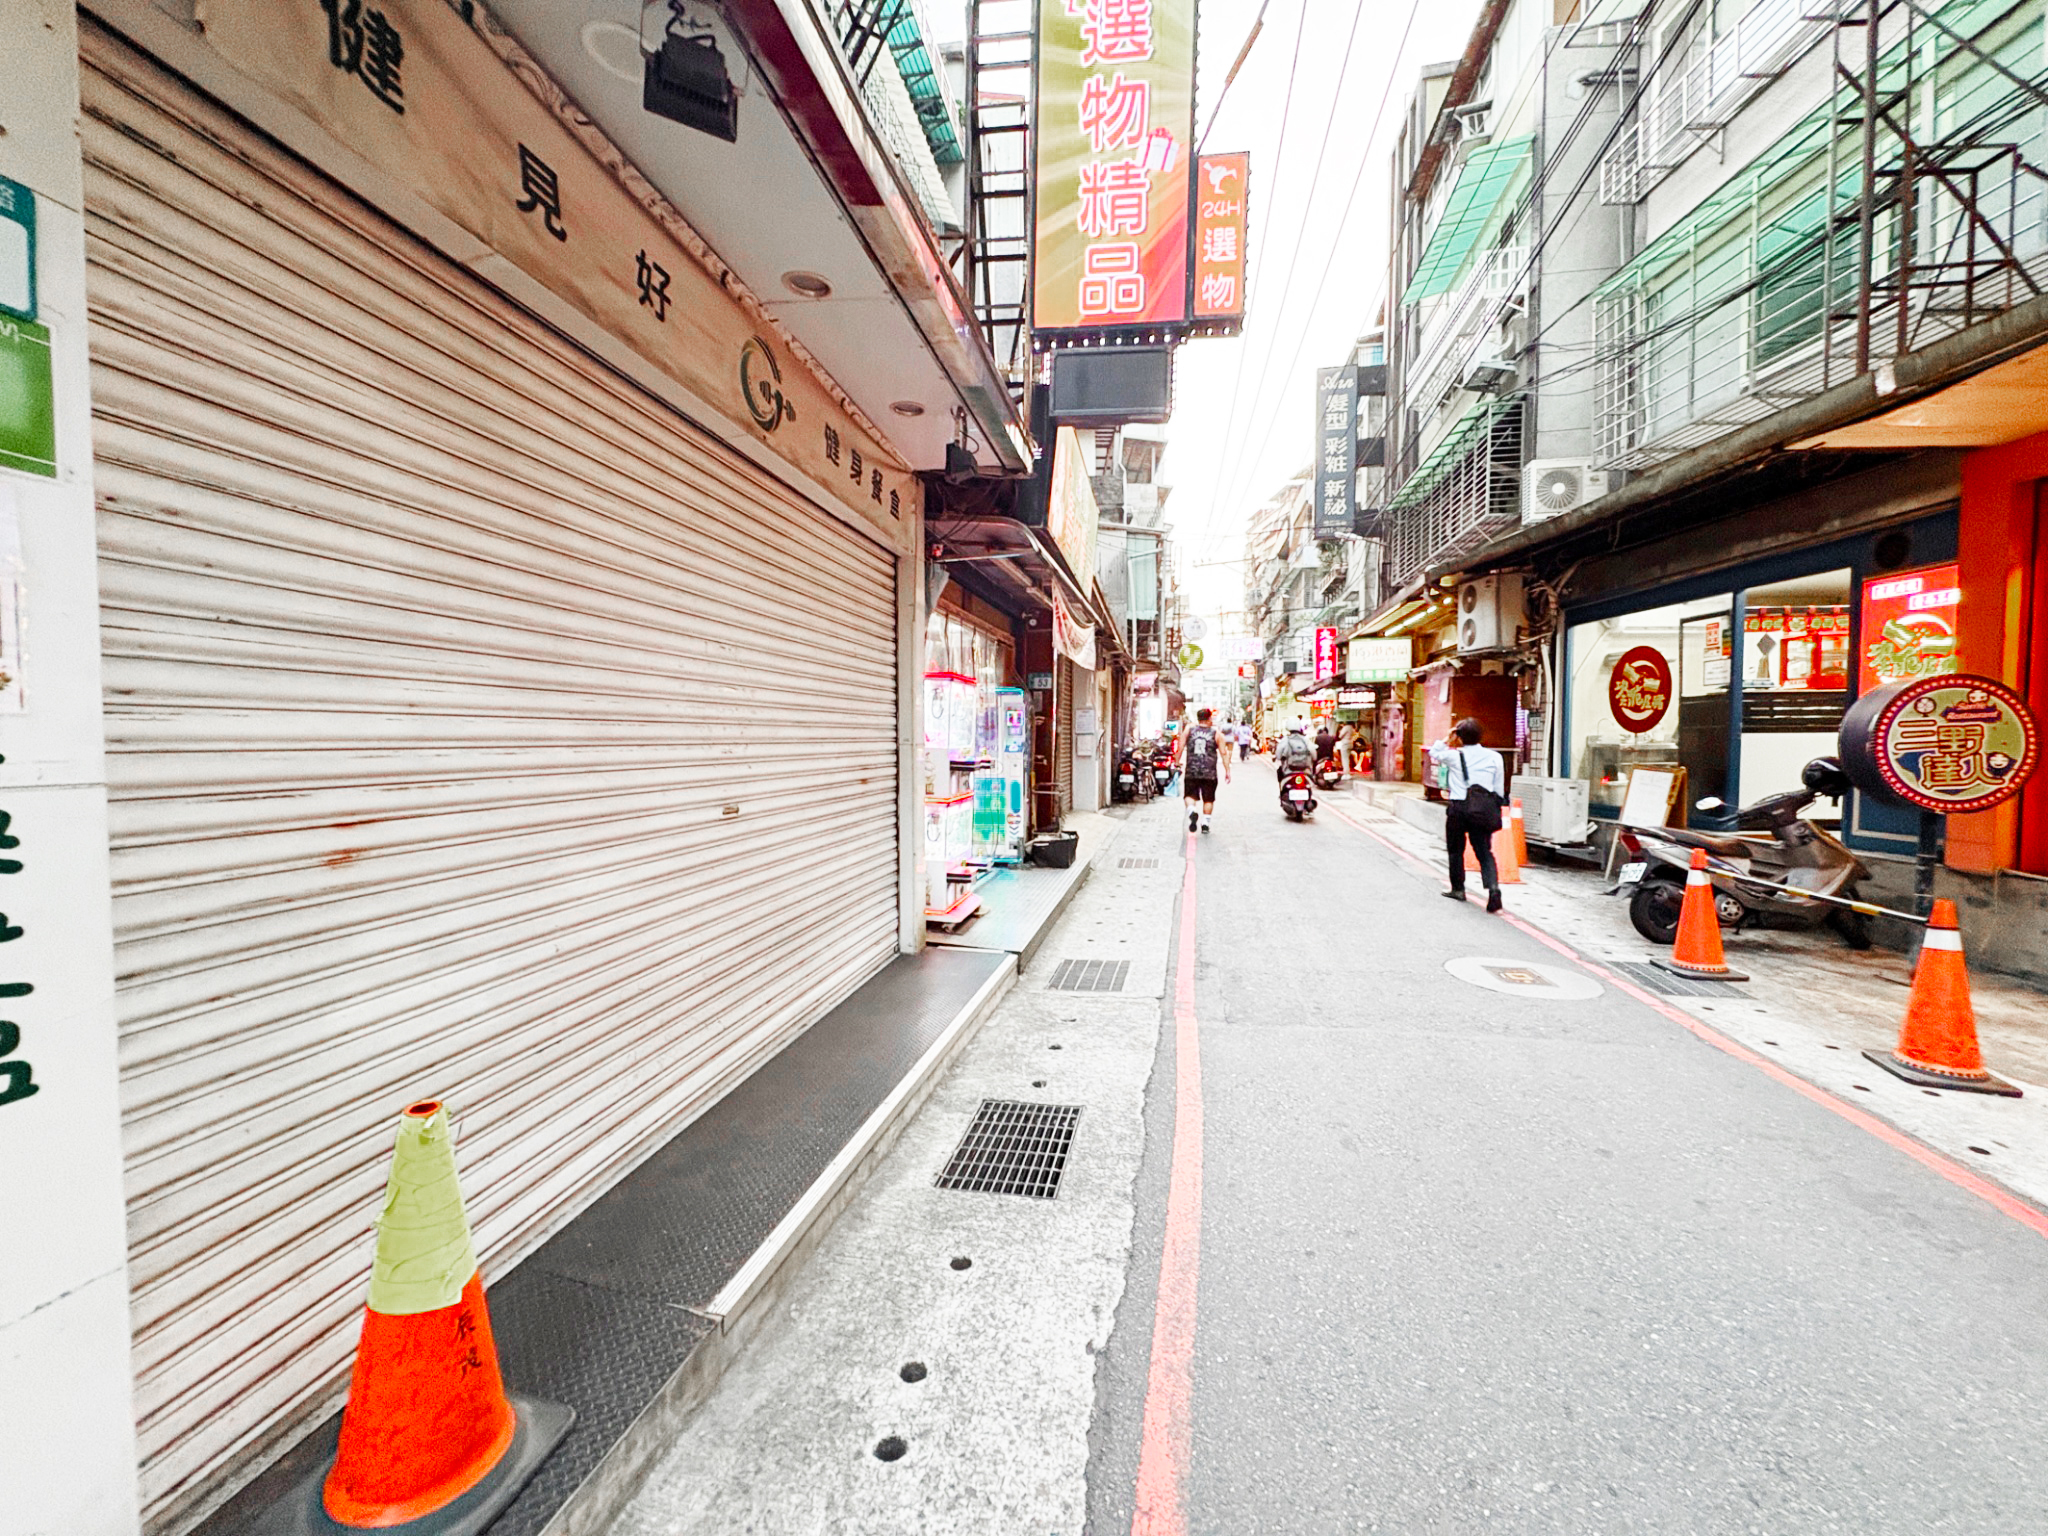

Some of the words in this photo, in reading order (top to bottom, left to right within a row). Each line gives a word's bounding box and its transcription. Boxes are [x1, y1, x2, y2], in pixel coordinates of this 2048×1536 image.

[1077, 0, 1156, 316] 選物精品
[1202, 200, 1242, 219] 24H
[1202, 227, 1238, 310] 選物
[1320, 371, 1355, 391] Ann
[1037, 678, 1048, 688] 53
